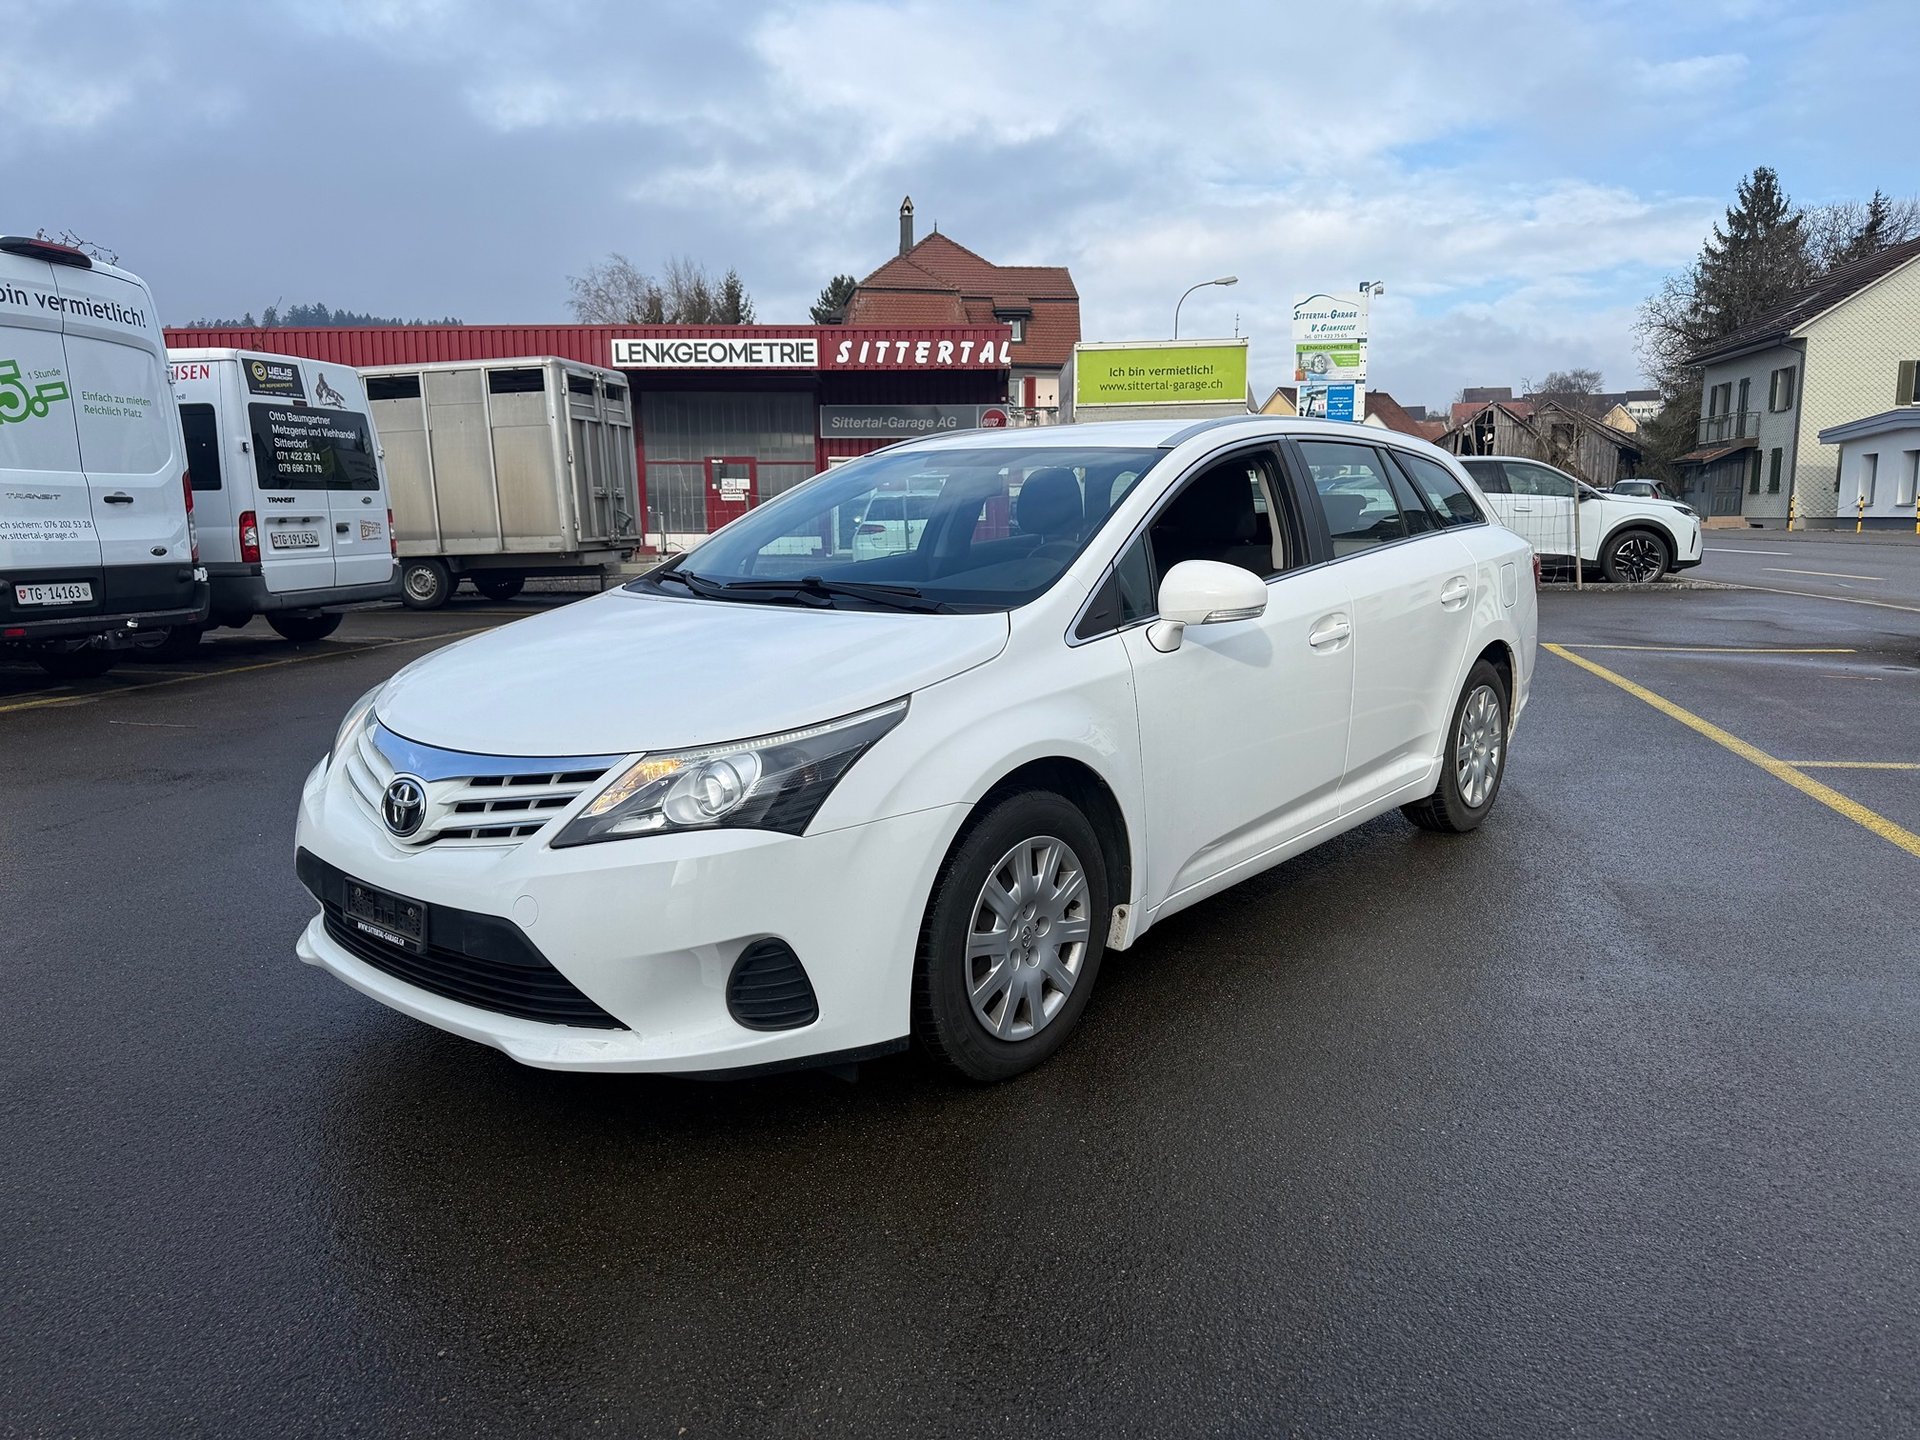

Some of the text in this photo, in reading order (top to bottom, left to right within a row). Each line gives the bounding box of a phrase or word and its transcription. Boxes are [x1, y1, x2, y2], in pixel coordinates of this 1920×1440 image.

[34, 292, 147, 328] vermietlich!
[1293, 309, 1358, 320] SITTERTAL-GARAGE
[614, 342, 815, 364] LENKGEOMETRIE
[835, 339, 1012, 365] SITTERTAL
[34, 367, 61, 379] Stunde
[1109, 365, 1214, 377] Ich bin vermietlich!
[1099, 379, 1223, 391] www.sittertal-garage.ch
[82, 391, 152, 407] Einfach zu mieten
[84, 404, 143, 418] Reichlich Platz
[268, 410, 331, 425] Otto Baumgartner
[831, 416, 957, 431] Sittertal-Garage AG
[271, 424, 357, 440] Metzgerei und Viehhandel
[274, 437, 308, 449] Sitterdorf
[276, 451, 289, 461] 071
[290, 452, 303, 461] 422
[313, 452, 320, 461] 74
[278, 463, 291, 473] 079
[305, 464, 313, 473] 71
[267, 496, 296, 504] TRANSIT
[11, 520, 43, 529] sichern:
[43, 520, 58, 529] 076
[59, 520, 71, 529] 202
[72, 520, 82, 529] 53
[82, 520, 93, 529] 28
